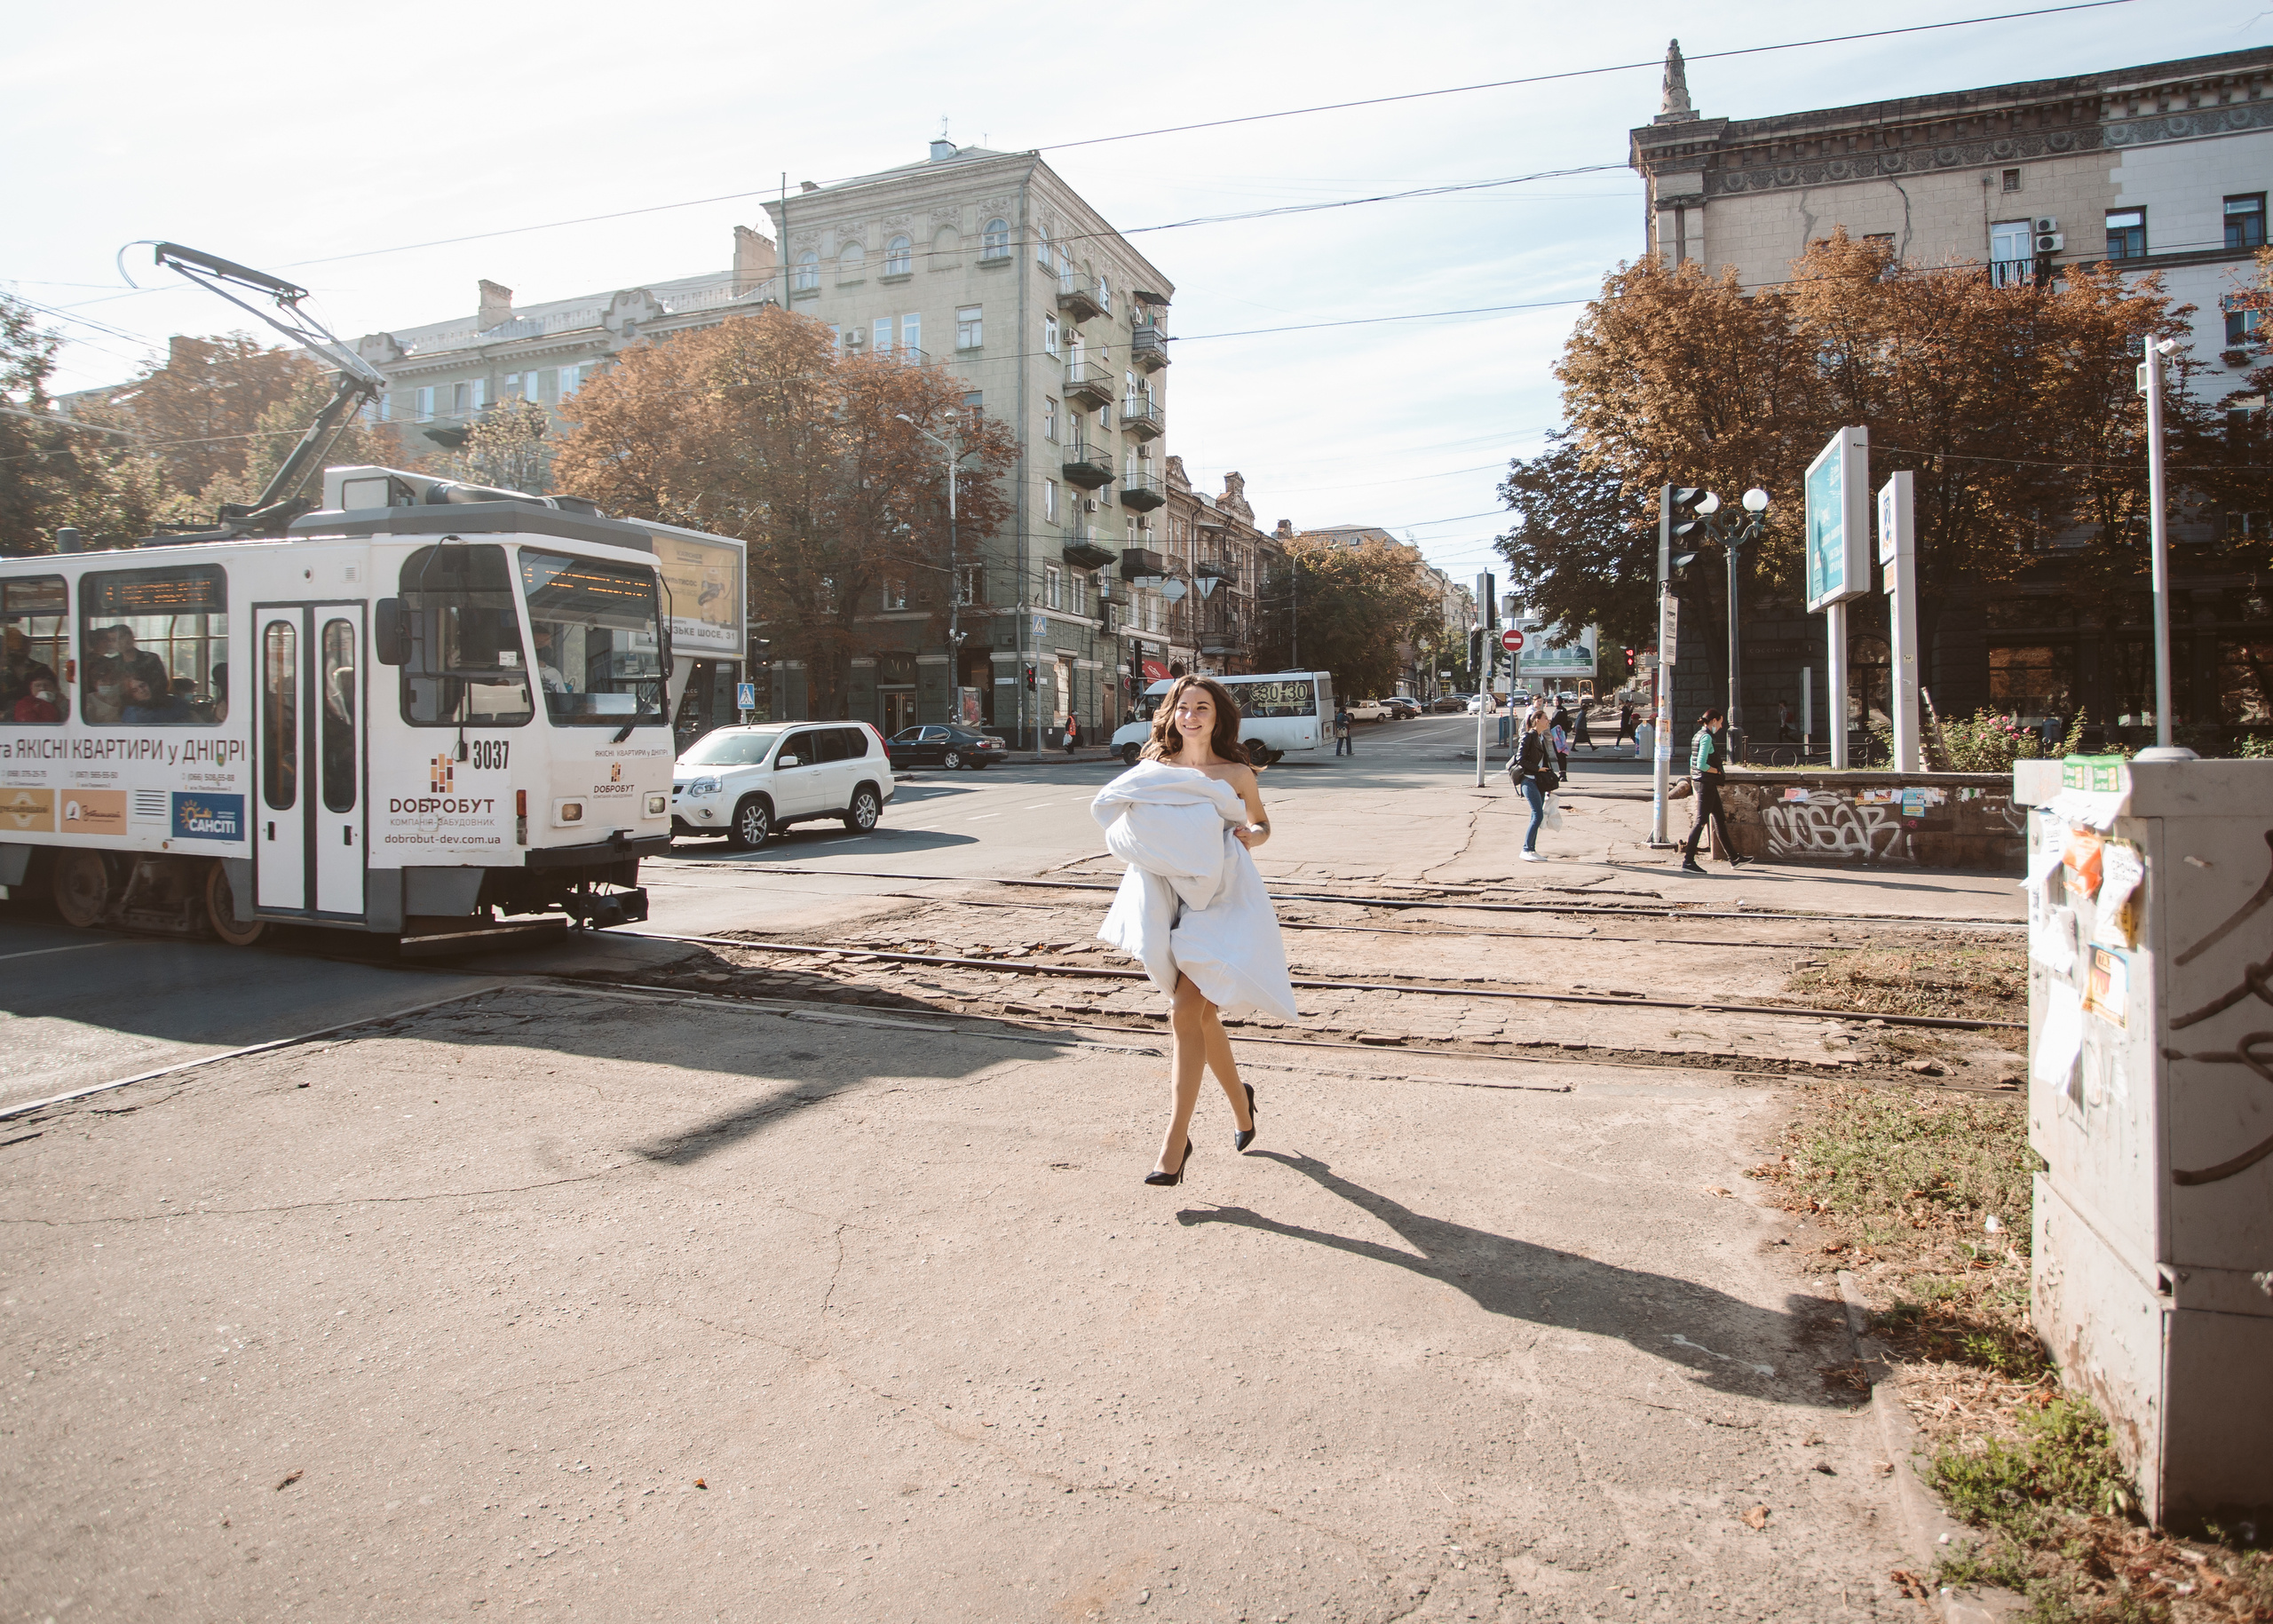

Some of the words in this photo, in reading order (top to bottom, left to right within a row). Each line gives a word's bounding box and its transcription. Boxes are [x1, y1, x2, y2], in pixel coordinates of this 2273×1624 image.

[697, 629, 724, 639] ШОСЕ,
[17, 739, 67, 758] ЯКІСНІ
[73, 739, 163, 759] КВАРТИРИ
[168, 745, 178, 765] у
[182, 740, 245, 764] ДНІПРІ
[473, 740, 510, 770] 3037
[188, 819, 236, 834] САНСІТІ
[384, 835, 501, 844] dobrobut-dev.com.ua
